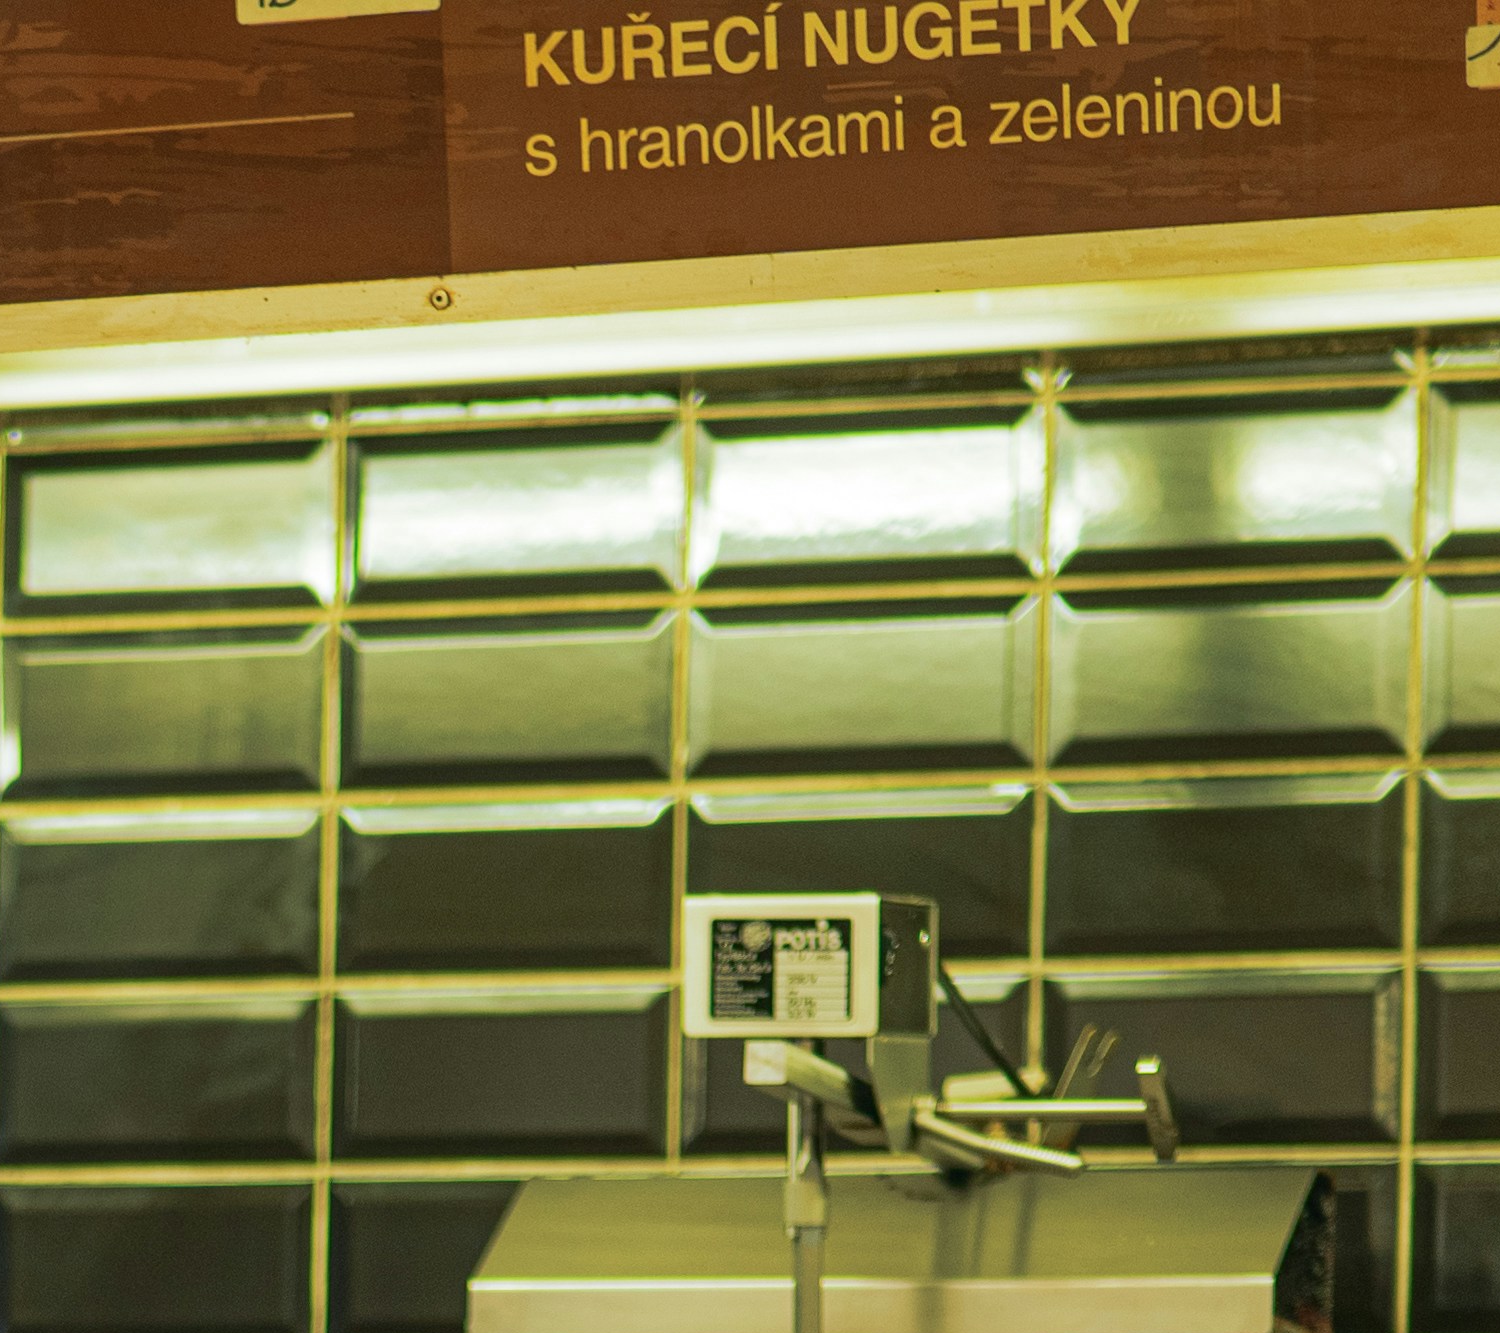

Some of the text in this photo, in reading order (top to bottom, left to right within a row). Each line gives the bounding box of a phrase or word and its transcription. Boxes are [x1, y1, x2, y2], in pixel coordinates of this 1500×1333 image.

[524, 0, 1139, 88] KUŘECÍ NUGETKY
[525, 77, 1281, 177] s hranolkami a zeleninou
